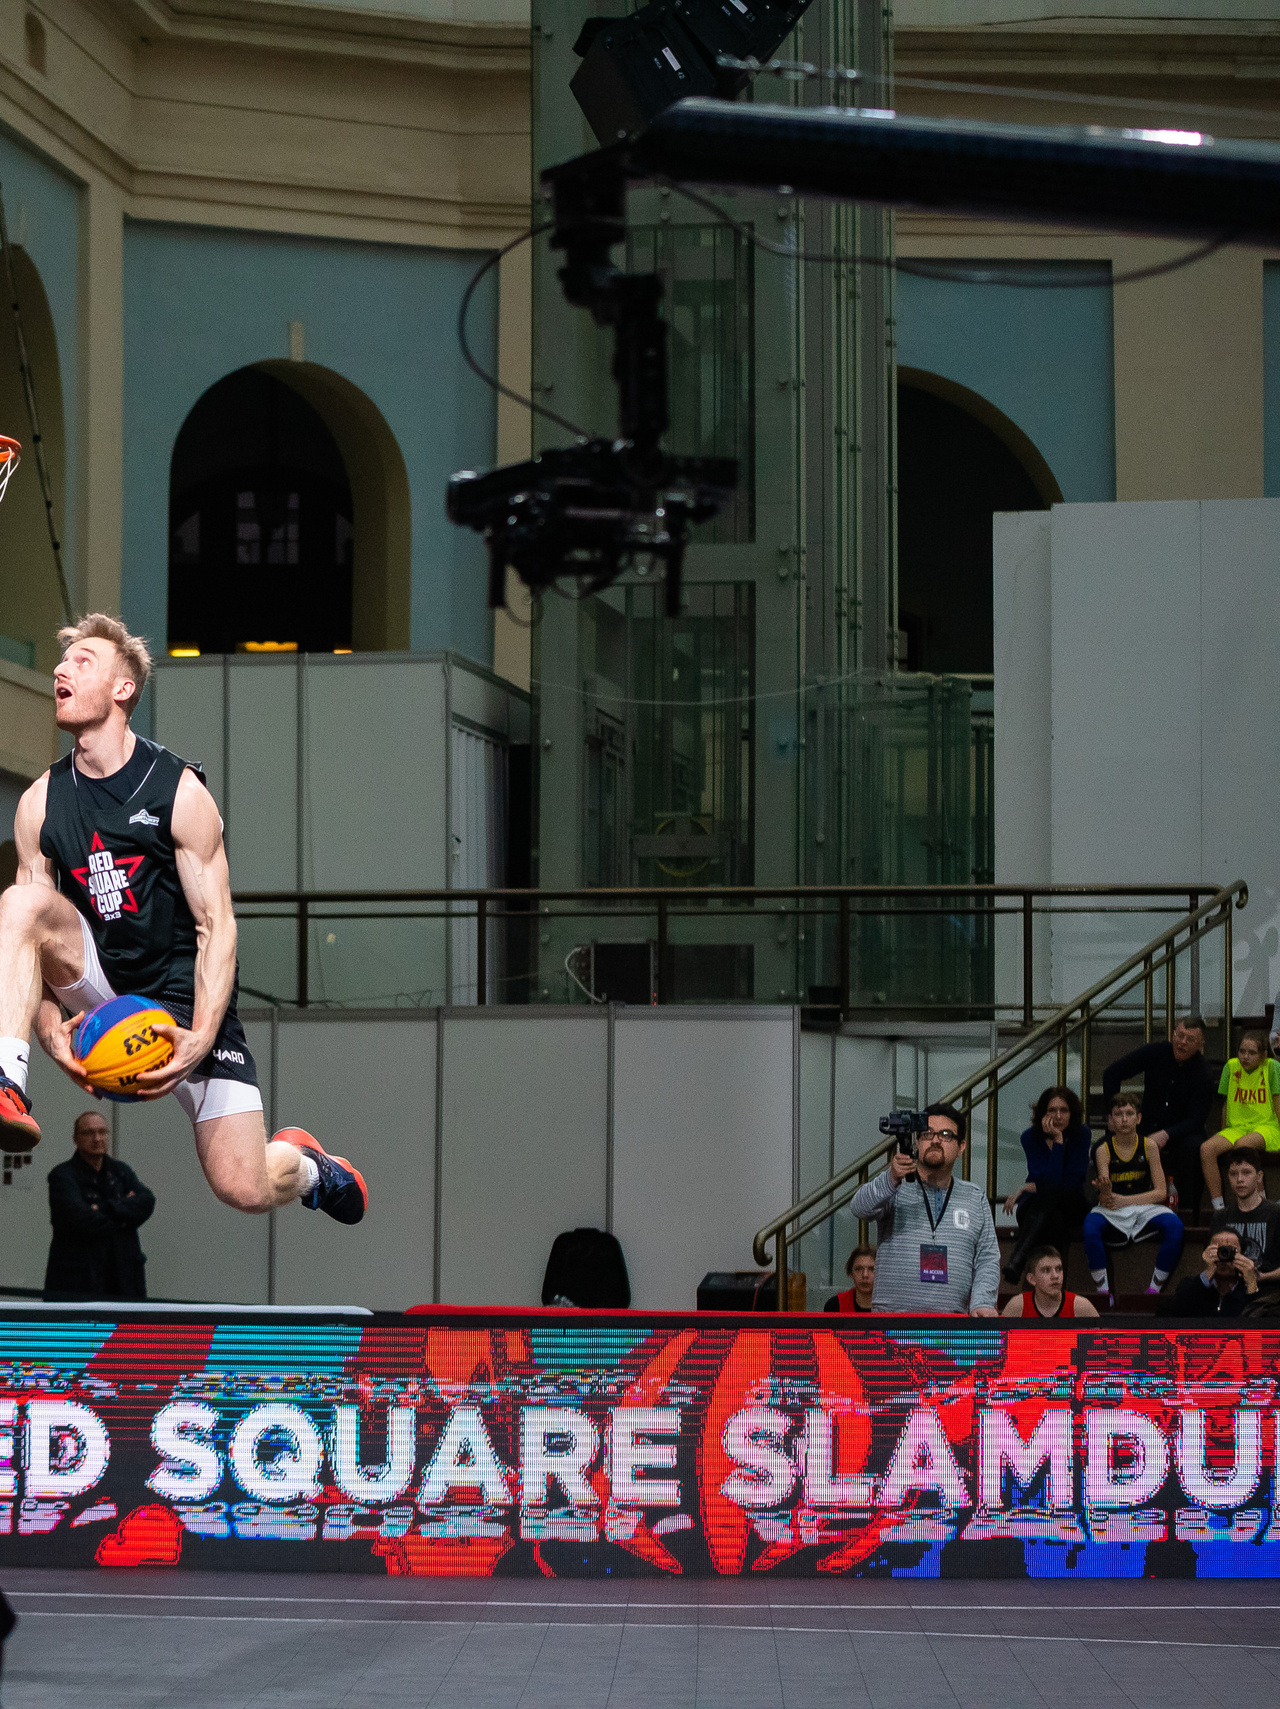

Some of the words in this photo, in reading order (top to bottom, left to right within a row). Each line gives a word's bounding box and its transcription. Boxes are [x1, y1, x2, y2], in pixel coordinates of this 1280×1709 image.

[87, 850, 115, 875] RED
[87, 868, 131, 897] SUARE
[96, 889, 124, 915] CUP
[144, 1399, 683, 1508] SQUARE
[720, 1405, 1280, 1509] SLAMDU
